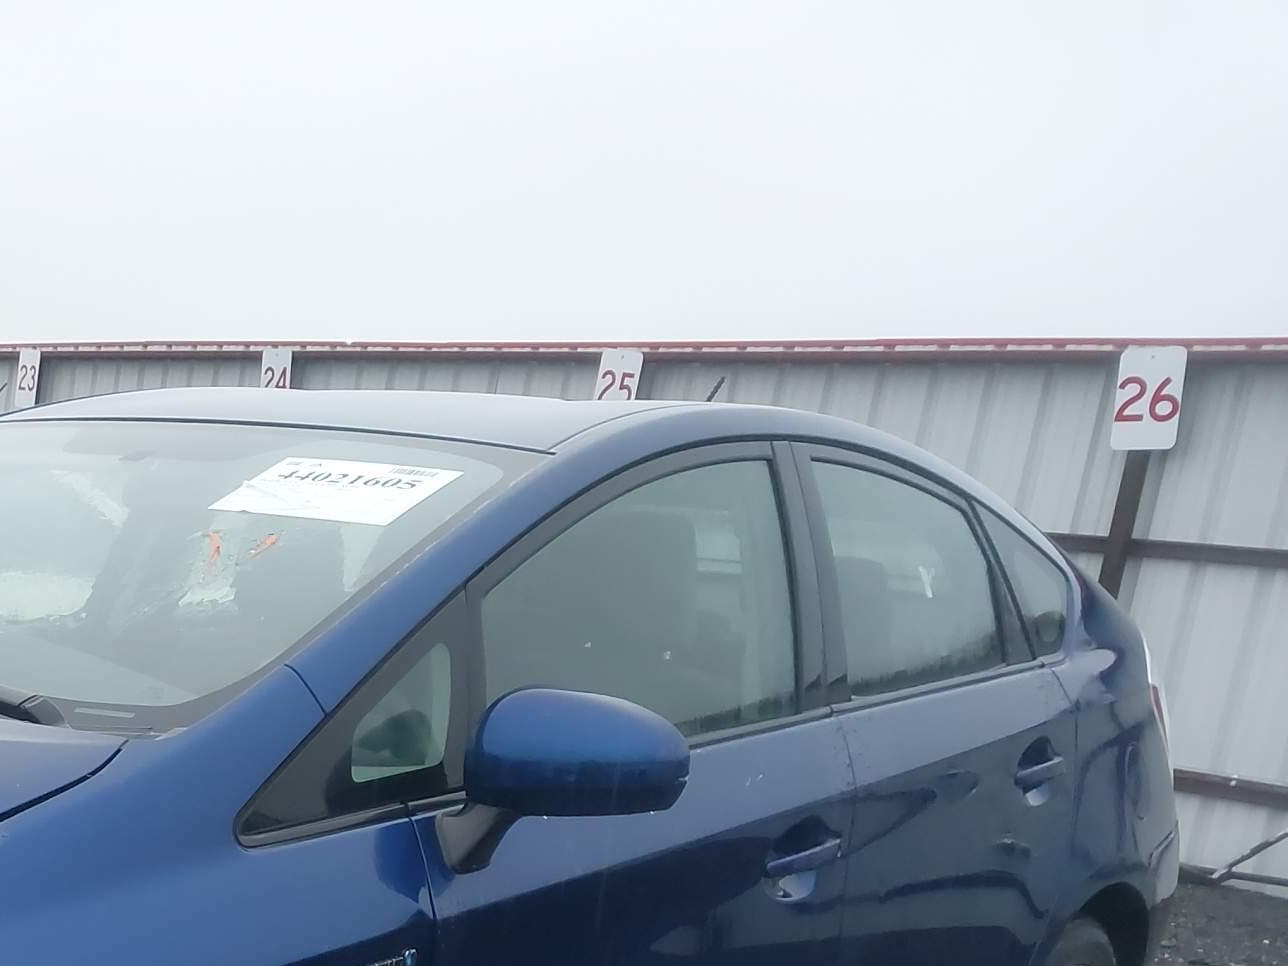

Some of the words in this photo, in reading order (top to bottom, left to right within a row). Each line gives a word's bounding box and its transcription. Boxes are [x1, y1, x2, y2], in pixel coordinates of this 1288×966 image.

[18, 364, 37, 392] 23
[263, 366, 288, 389] 24
[597, 369, 635, 401] 25
[1114, 376, 1179, 422] 26
[277, 469, 425, 490] 44021605
